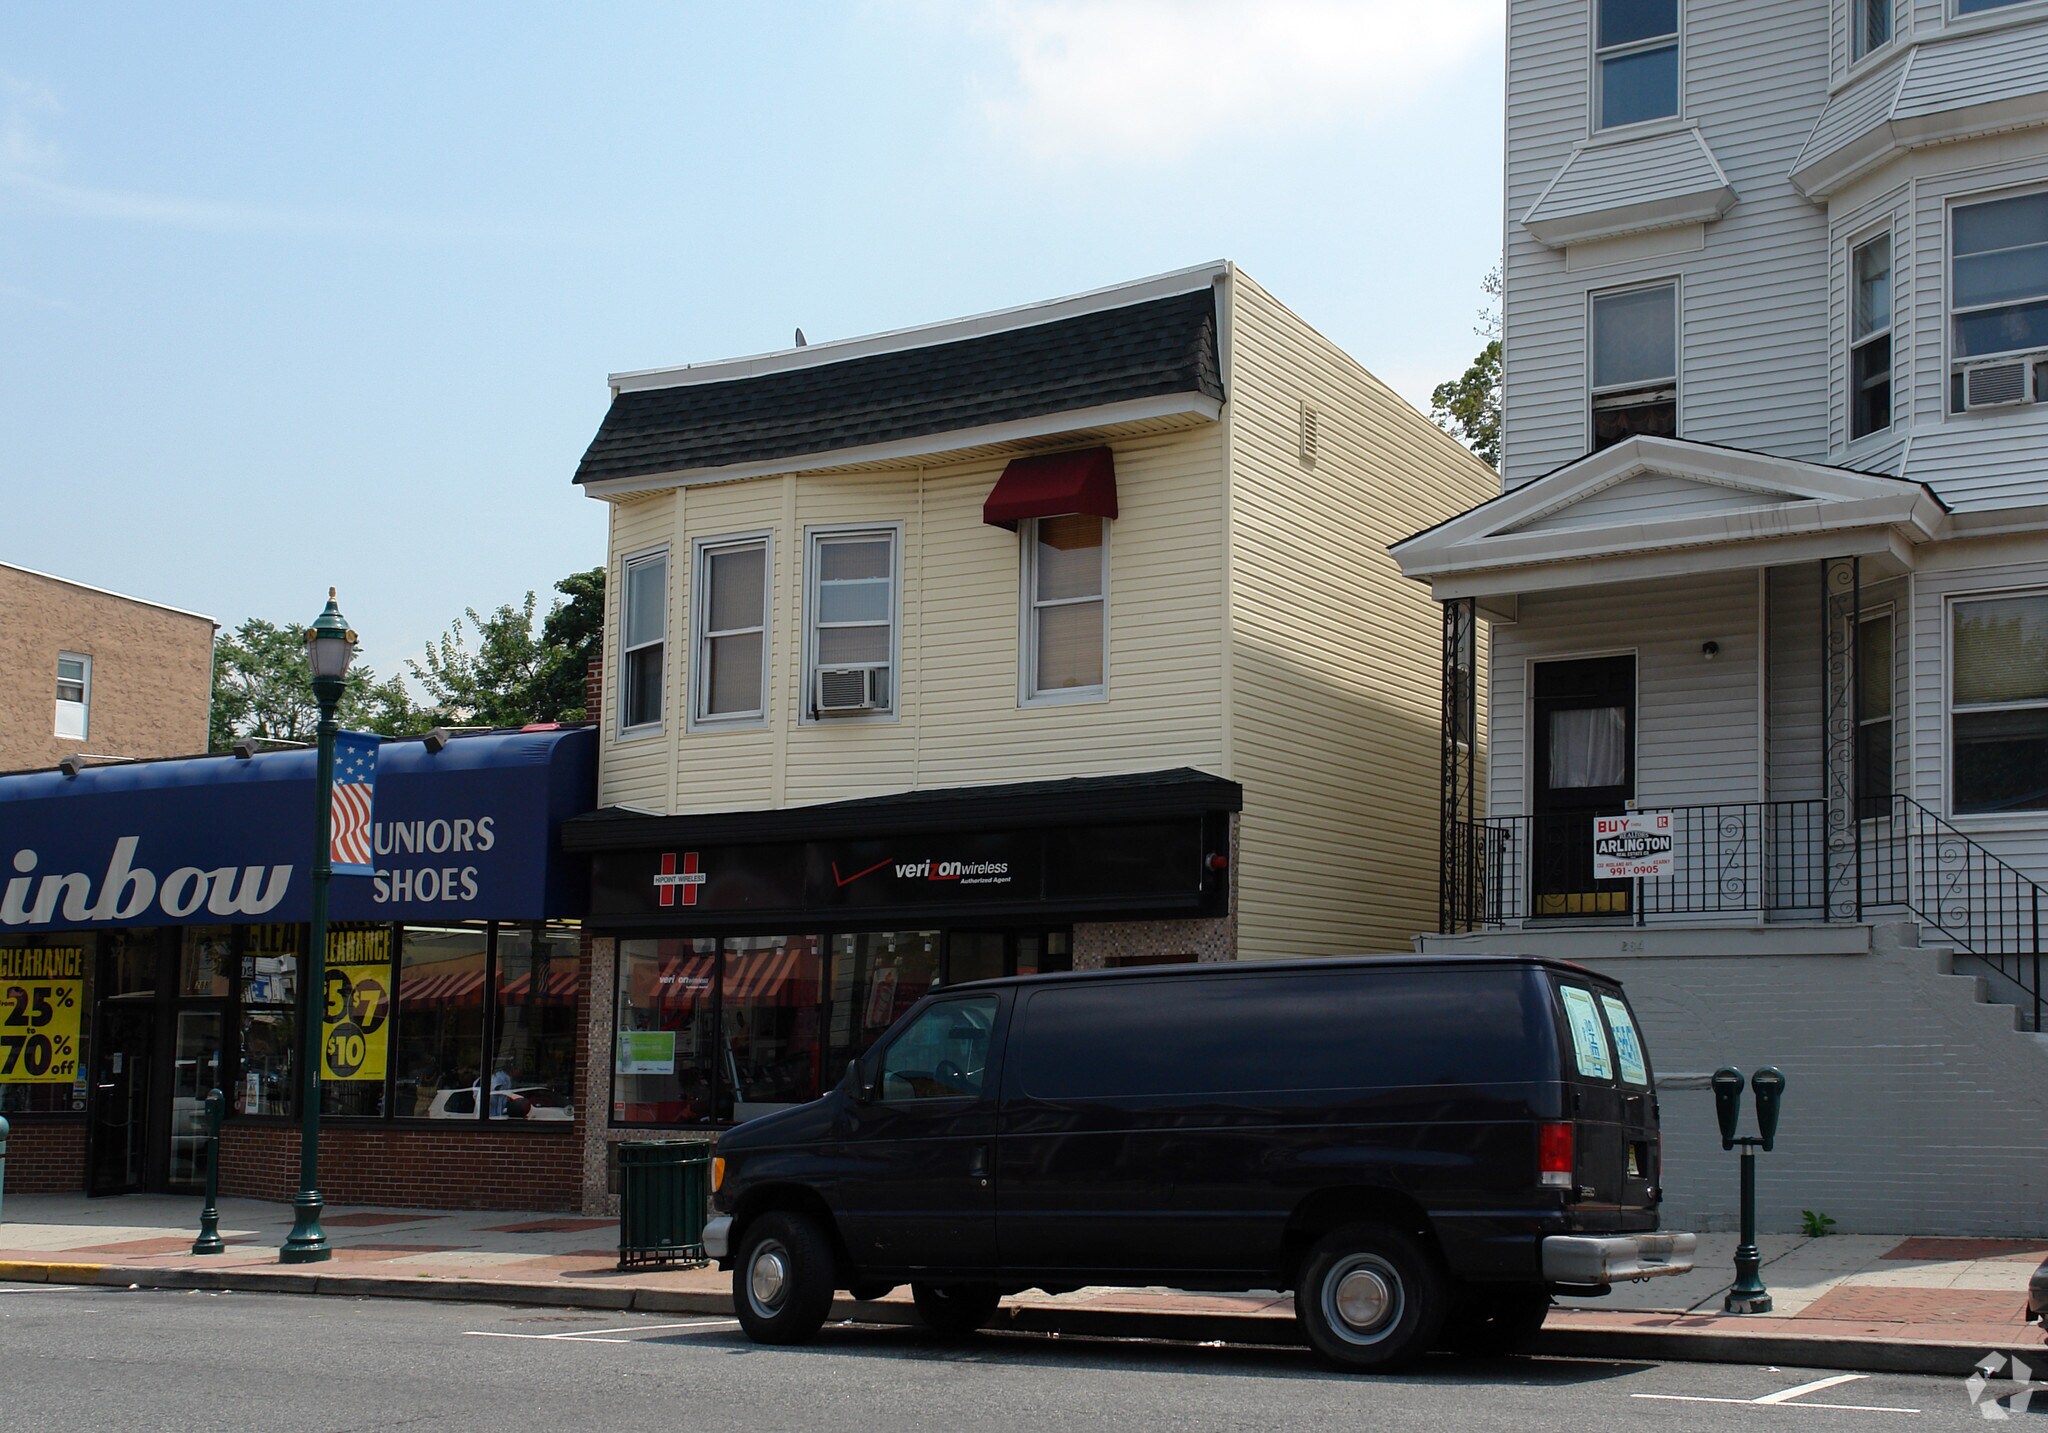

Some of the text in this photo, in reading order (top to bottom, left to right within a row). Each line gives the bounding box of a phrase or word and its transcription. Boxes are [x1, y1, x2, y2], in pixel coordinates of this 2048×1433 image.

[373, 816, 495, 855] UNIORS
[1598, 819, 1630, 832] BUY
[1599, 836, 1670, 853] ARLINGTON
[373, 867, 478, 903] SHOES
[655, 876, 676, 884] HIPOINT
[0, 948, 82, 977] CLEARANCE
[353, 989, 382, 1027] $7
[27, 1027, 36, 1035] to
[328, 1035, 365, 1067] $10
[51, 1061, 75, 1075] off
